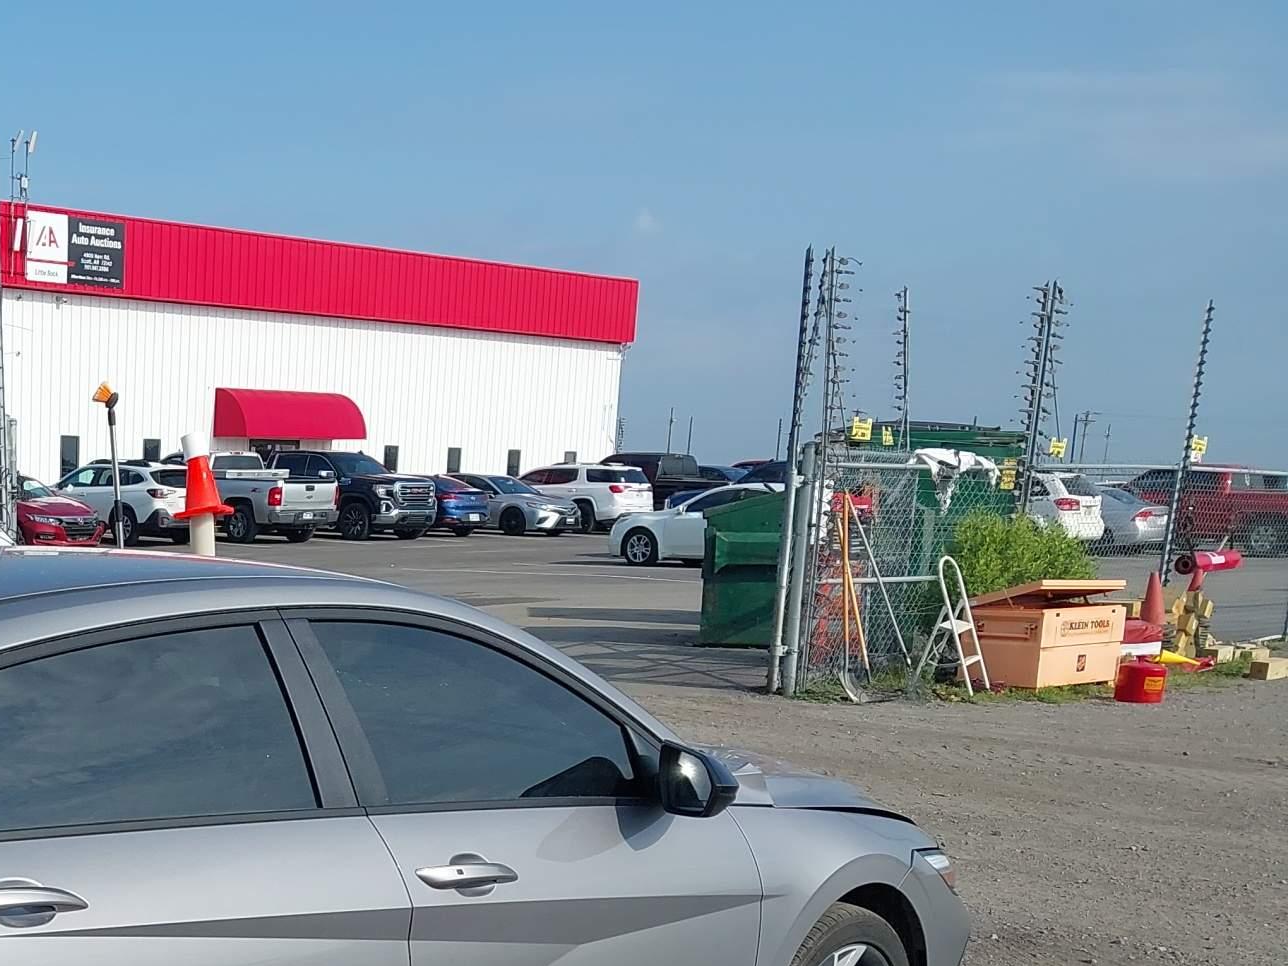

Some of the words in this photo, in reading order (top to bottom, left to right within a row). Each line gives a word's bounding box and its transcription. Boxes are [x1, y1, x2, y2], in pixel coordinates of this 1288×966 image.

[78, 222, 115, 236] Insurance
[72, 233, 89, 246] Auto
[89, 236, 122, 249] Auctions
[1069, 621, 1089, 630] KLEIN
[1091, 619, 1110, 629] TOOLS
